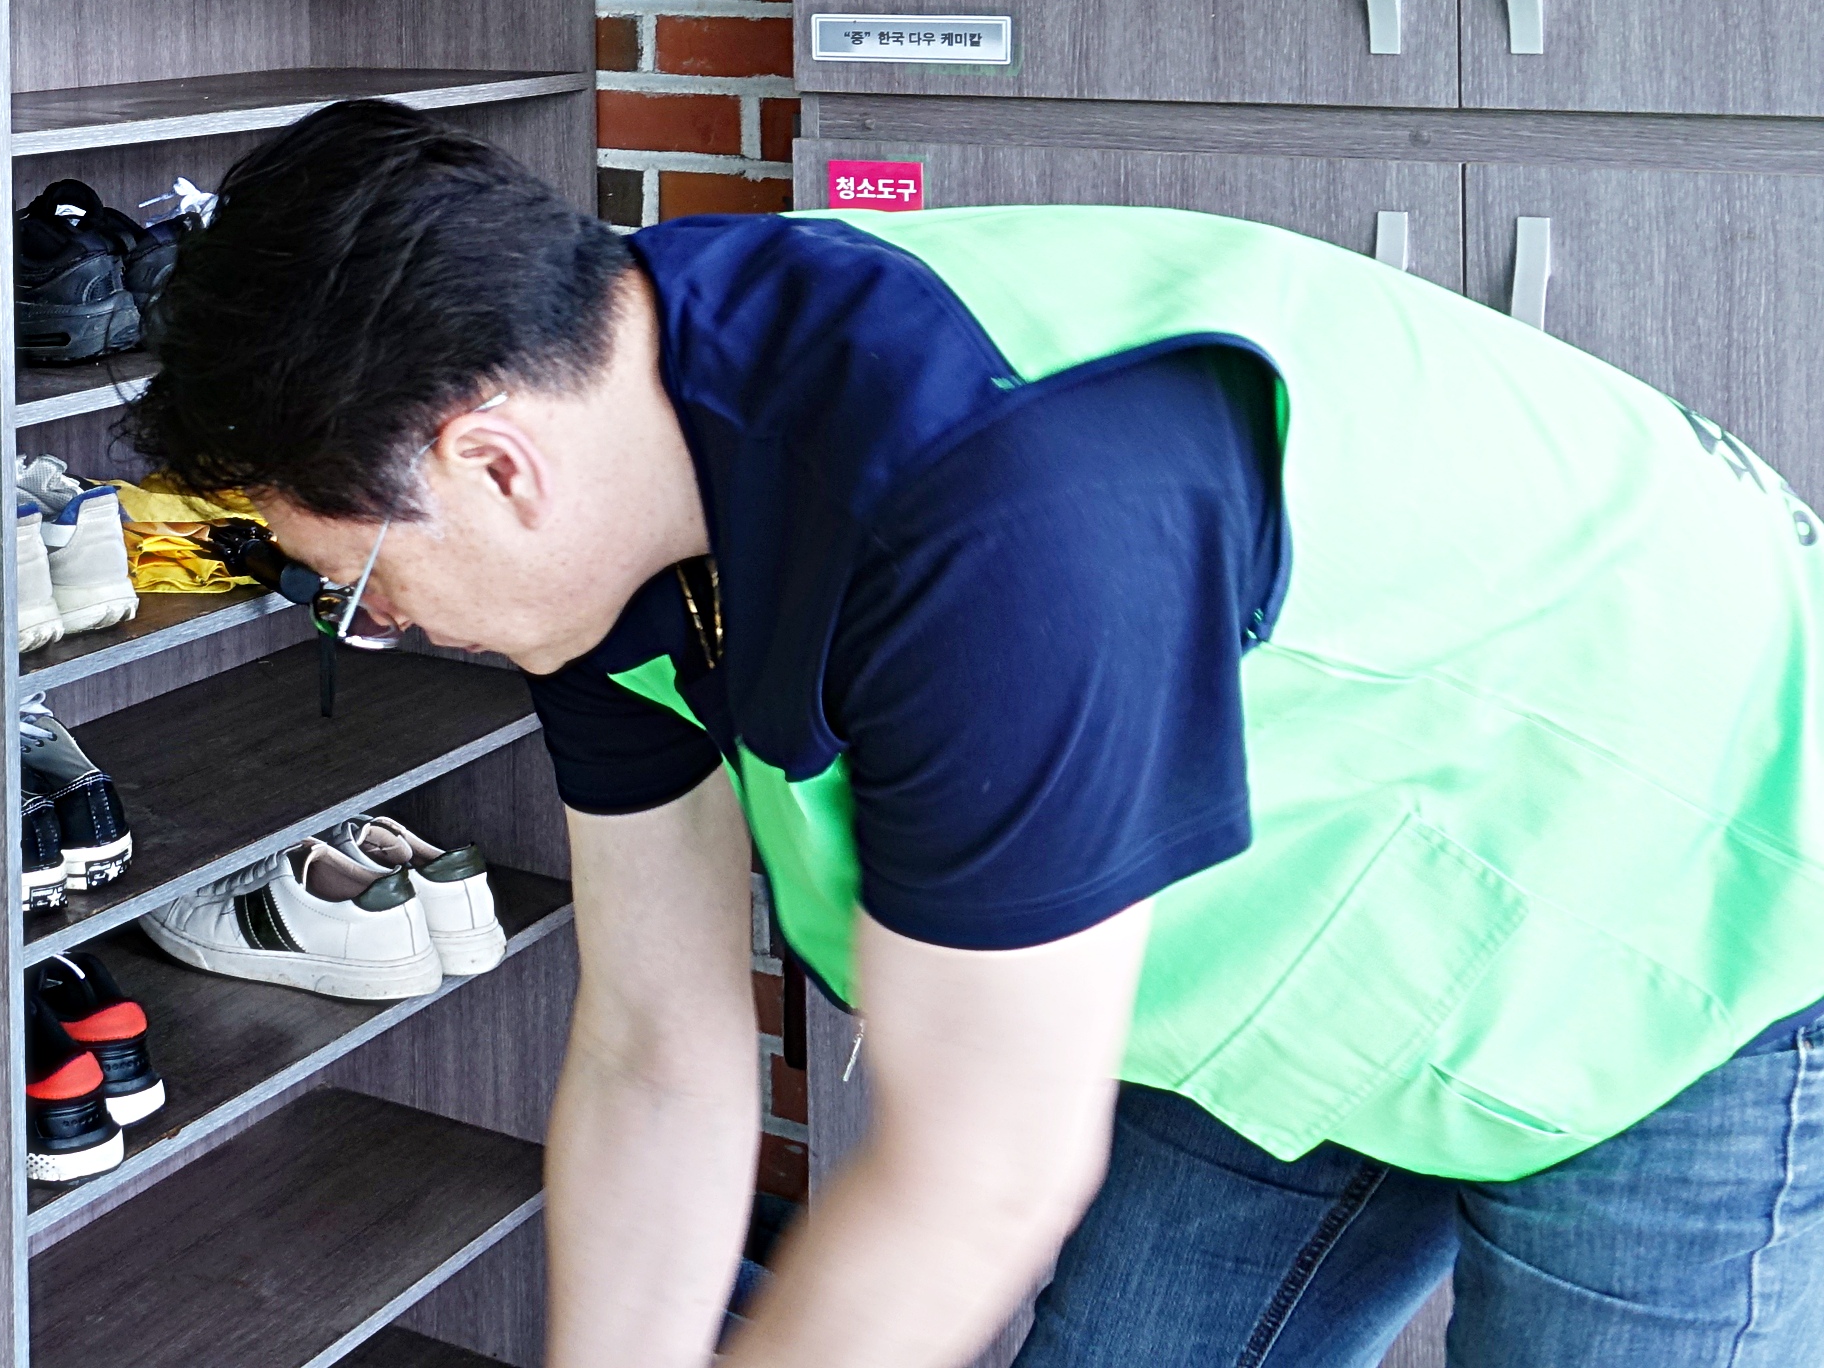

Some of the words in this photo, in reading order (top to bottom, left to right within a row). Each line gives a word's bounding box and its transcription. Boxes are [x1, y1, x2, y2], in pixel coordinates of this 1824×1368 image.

[877, 31, 905, 46] 한국
[908, 32, 936, 47] 다우
[940, 32, 983, 47] 케미칼
[835, 176, 918, 202] 청소도구
